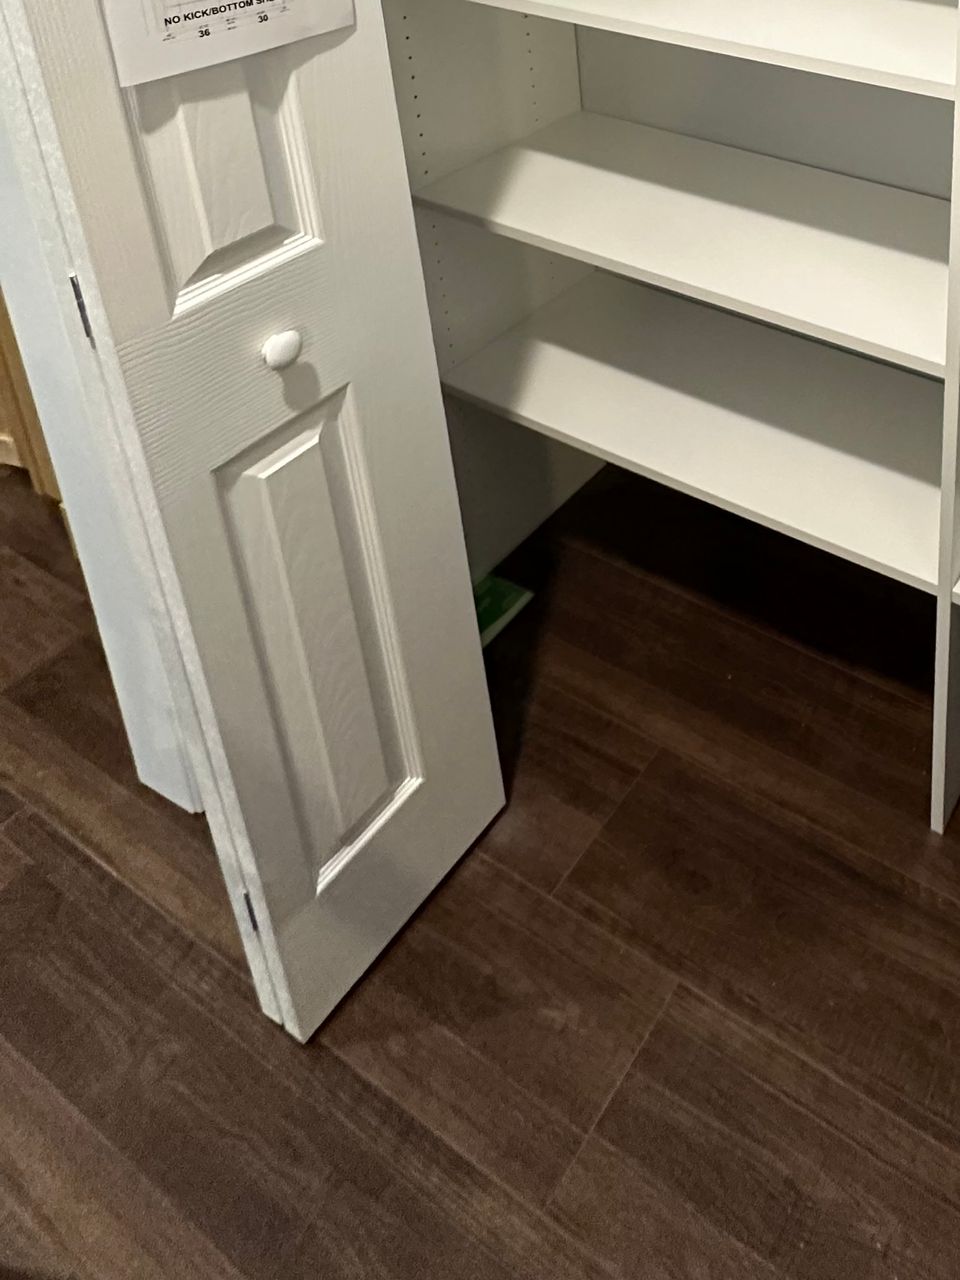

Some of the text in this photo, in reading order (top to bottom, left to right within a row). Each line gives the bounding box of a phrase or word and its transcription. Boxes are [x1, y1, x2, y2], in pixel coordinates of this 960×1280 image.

[164, 14, 181, 27] NO
[257, 13, 269, 23] 30
[198, 28, 211, 38] 36
